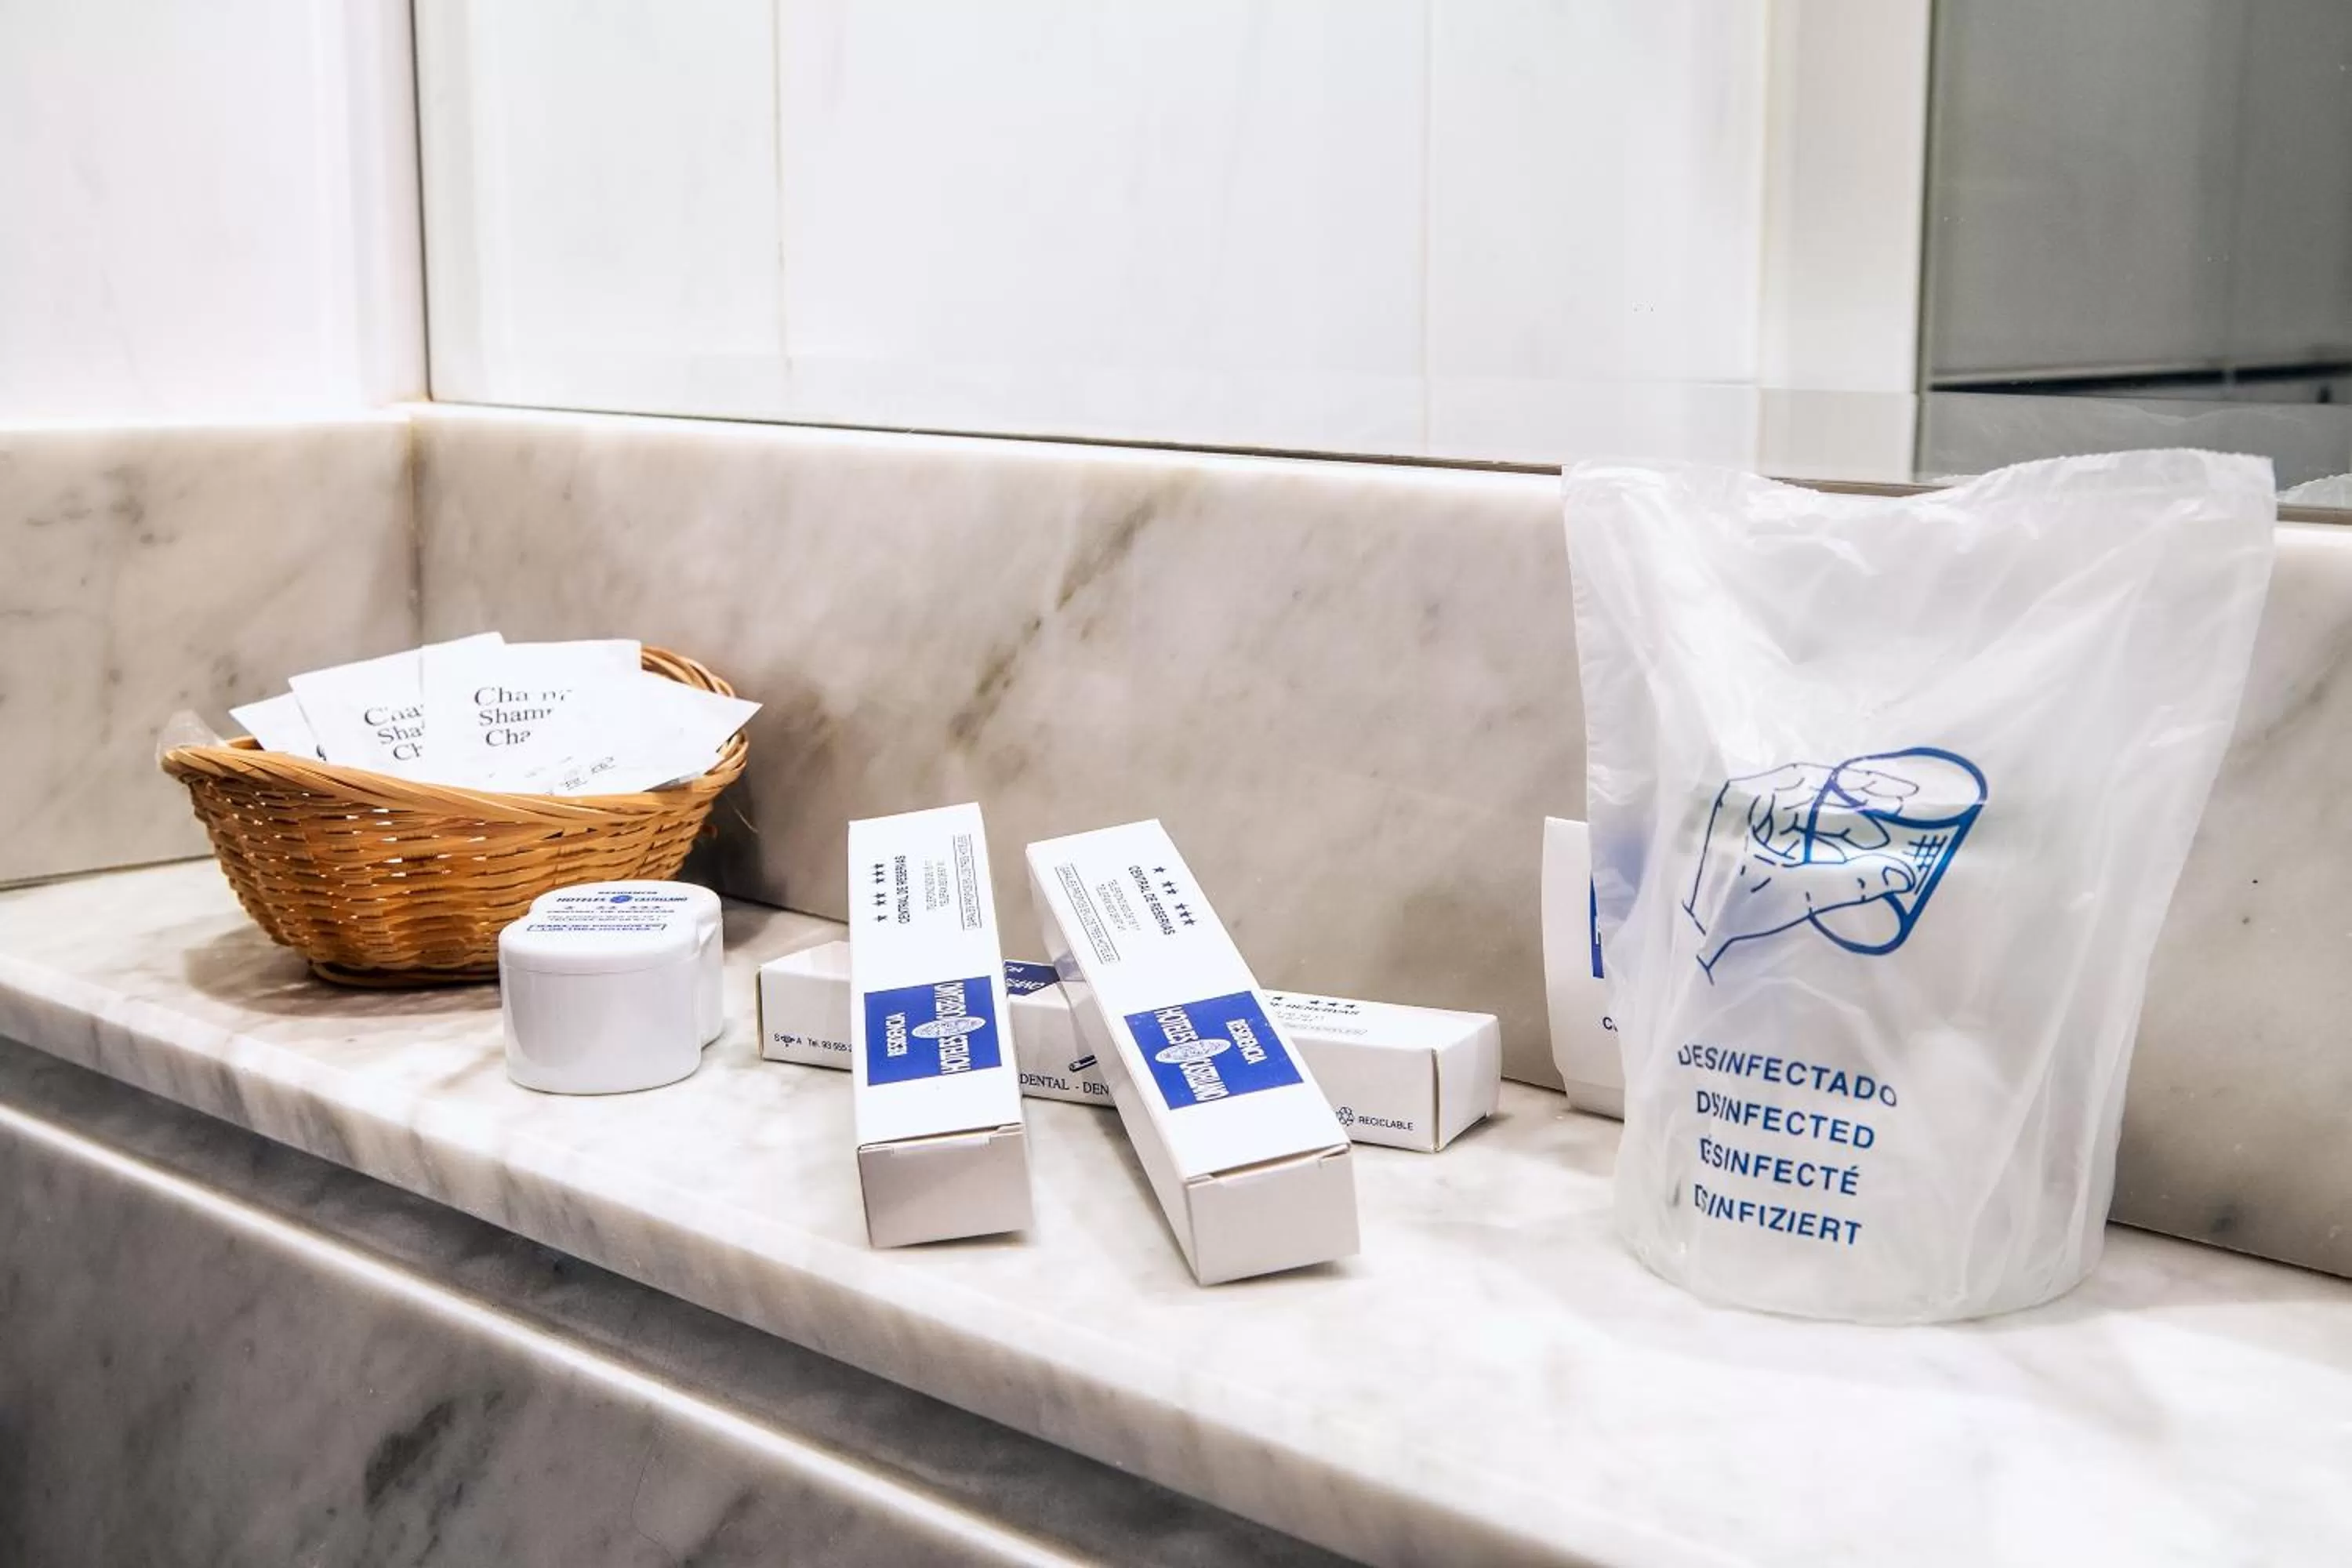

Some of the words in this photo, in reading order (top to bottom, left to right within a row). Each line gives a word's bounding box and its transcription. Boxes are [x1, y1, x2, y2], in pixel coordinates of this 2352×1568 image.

[377, 719, 425, 745] Sha
[885, 1011, 907, 1057] RESIDENCIA
[1154, 1004, 1199, 1045] HOTELES
[1225, 1018, 1268, 1065] RESIDENCIA
[938, 1034, 971, 1074] HOTELES
[1020, 1073, 1070, 1091] DENTAL
[1677, 1044, 1897, 1108] DESINFECTADO
[1358, 1116, 1414, 1131] RECICLABLE
